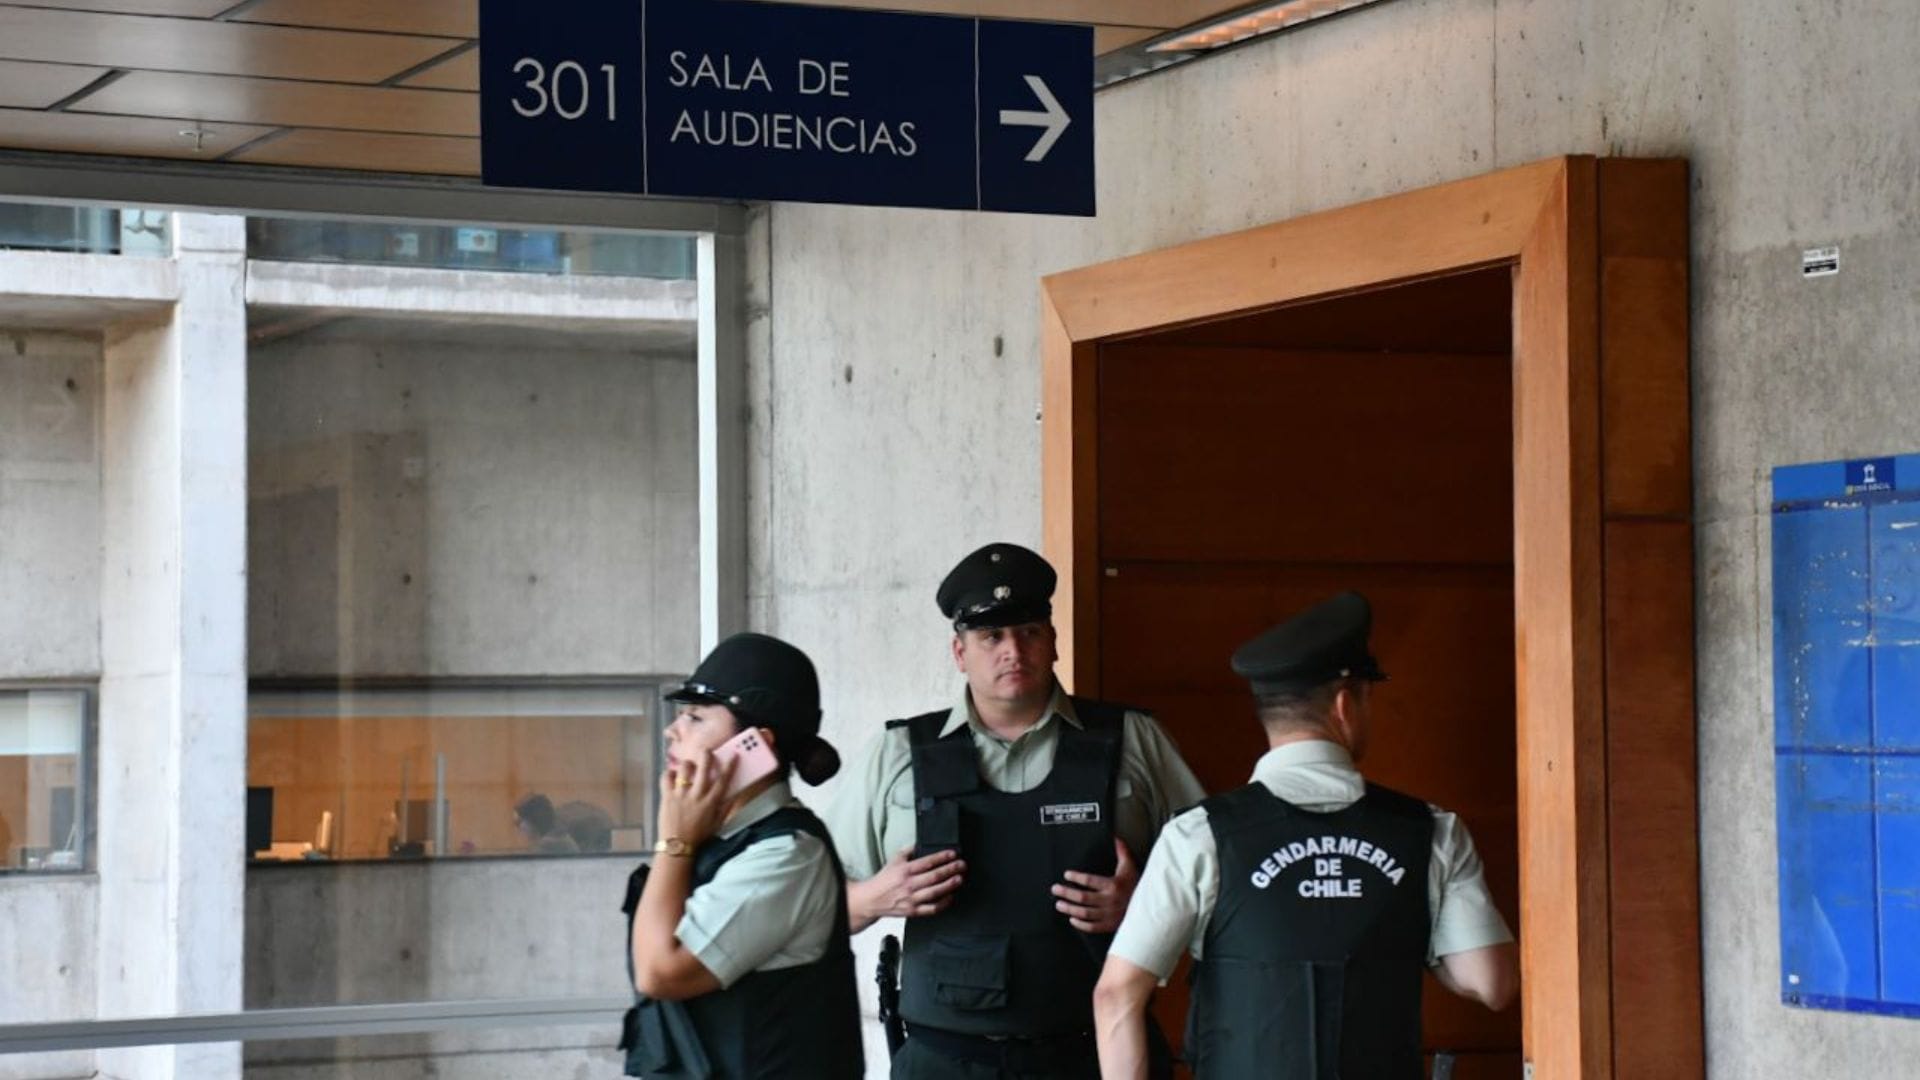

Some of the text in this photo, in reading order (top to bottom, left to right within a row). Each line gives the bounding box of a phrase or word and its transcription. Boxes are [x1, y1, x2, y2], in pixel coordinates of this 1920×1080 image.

[511, 57, 616, 121] 301
[669, 51, 850, 97] SALA DE
[670, 109, 917, 156] AUDIENCIAS
[1250, 836, 1406, 889] GENDARMERIA
[1315, 858, 1343, 876] DE
[1298, 878, 1363, 898] CHILE
